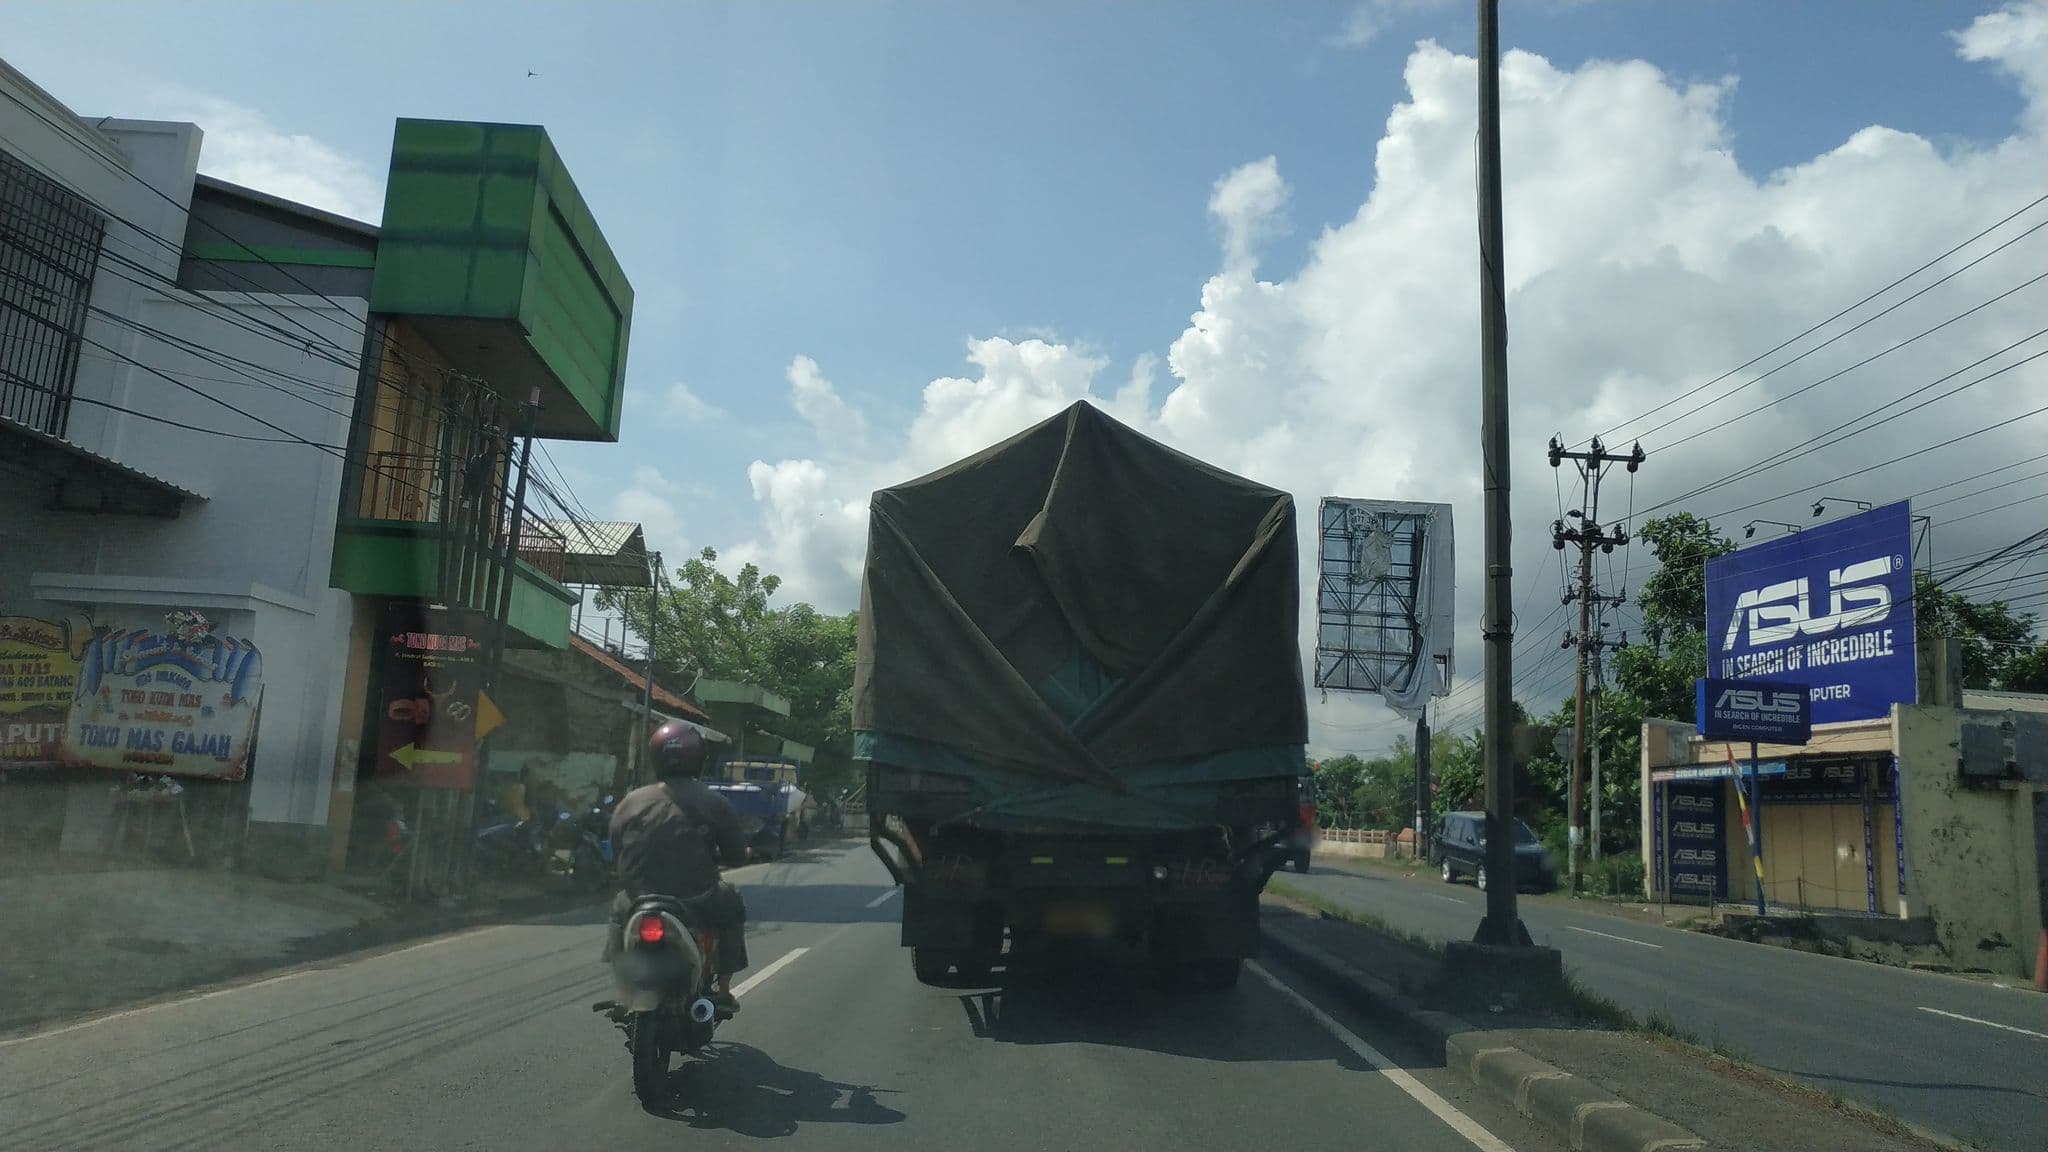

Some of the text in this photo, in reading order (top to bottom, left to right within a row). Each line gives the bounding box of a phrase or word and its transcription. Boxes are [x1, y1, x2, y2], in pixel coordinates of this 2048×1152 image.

[1722, 555, 1892, 651] ASUS
[1722, 629, 1894, 680] IN SEARCH OF INCREDIBLE
[1715, 689, 1801, 714] ASUS
[1714, 710, 1801, 724] IN SEARCH OF INCREDIBLE
[80, 723, 233, 758] TOKO MAS GAJAH
[1671, 794, 1715, 808] ASUS
[1672, 821, 1716, 834] ASUS
[1673, 848, 1716, 862] ASUS
[1673, 872, 1717, 886] ASUS
